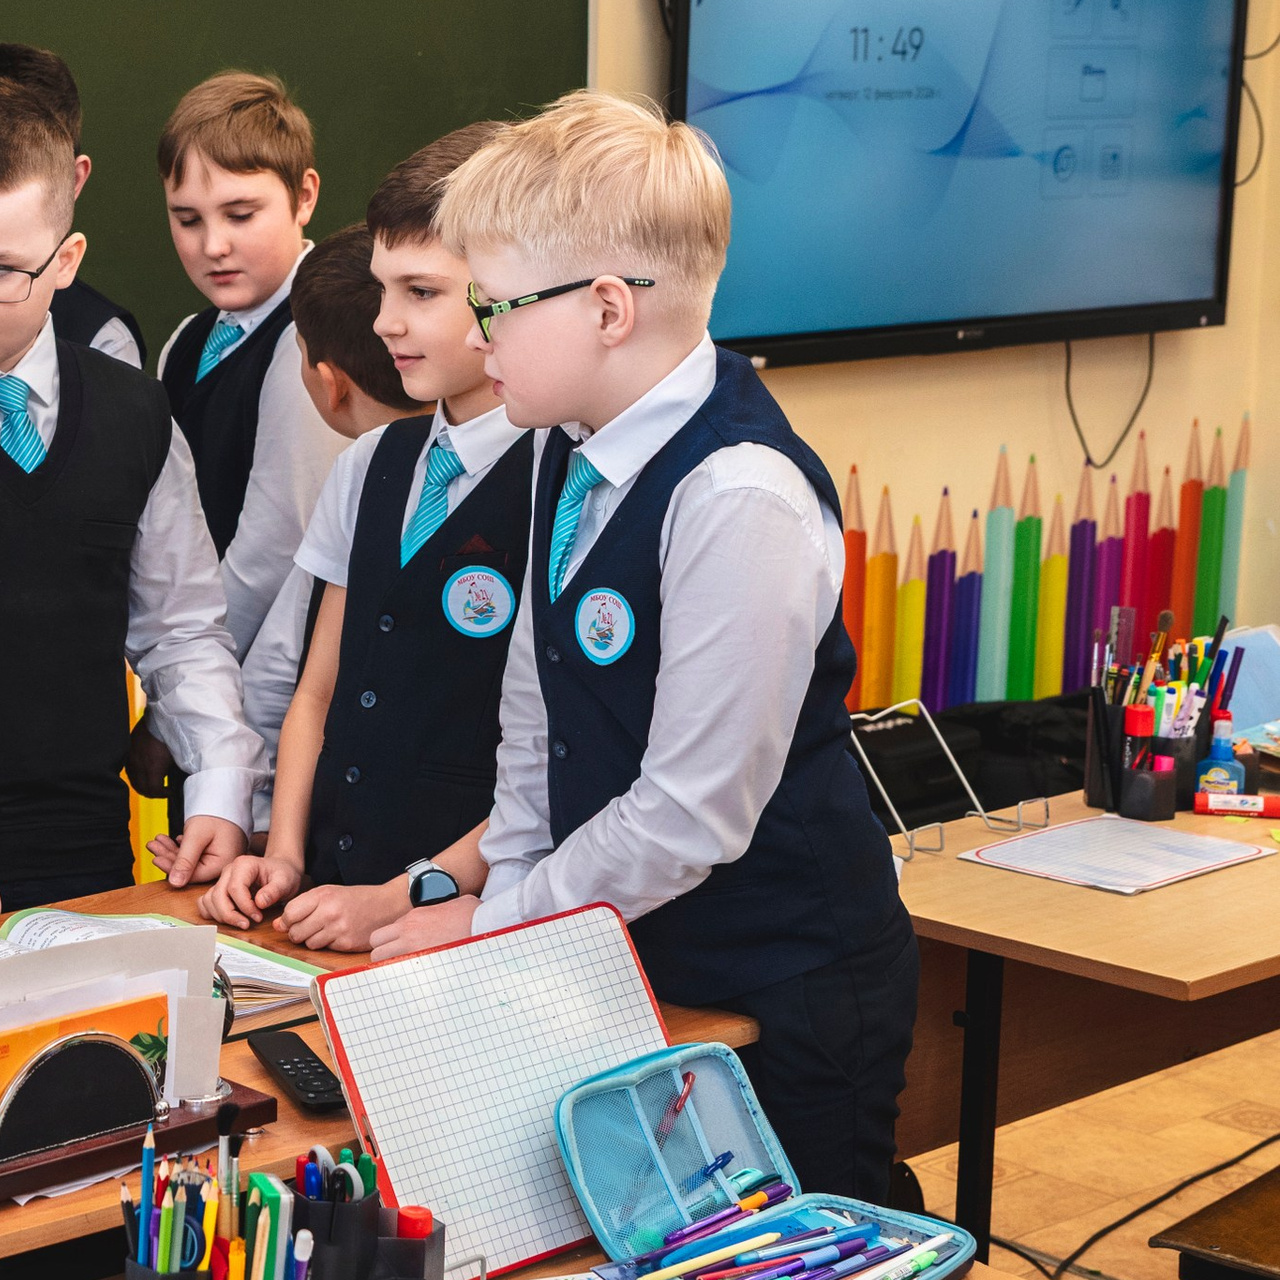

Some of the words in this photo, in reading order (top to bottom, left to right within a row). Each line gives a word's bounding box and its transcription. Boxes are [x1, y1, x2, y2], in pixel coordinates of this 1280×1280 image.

[457, 574, 476, 587] МБОУ
[477, 574, 495, 583] СОШ
[590, 593, 607, 603] МБОУ
[608, 596, 623, 610] СОШ
